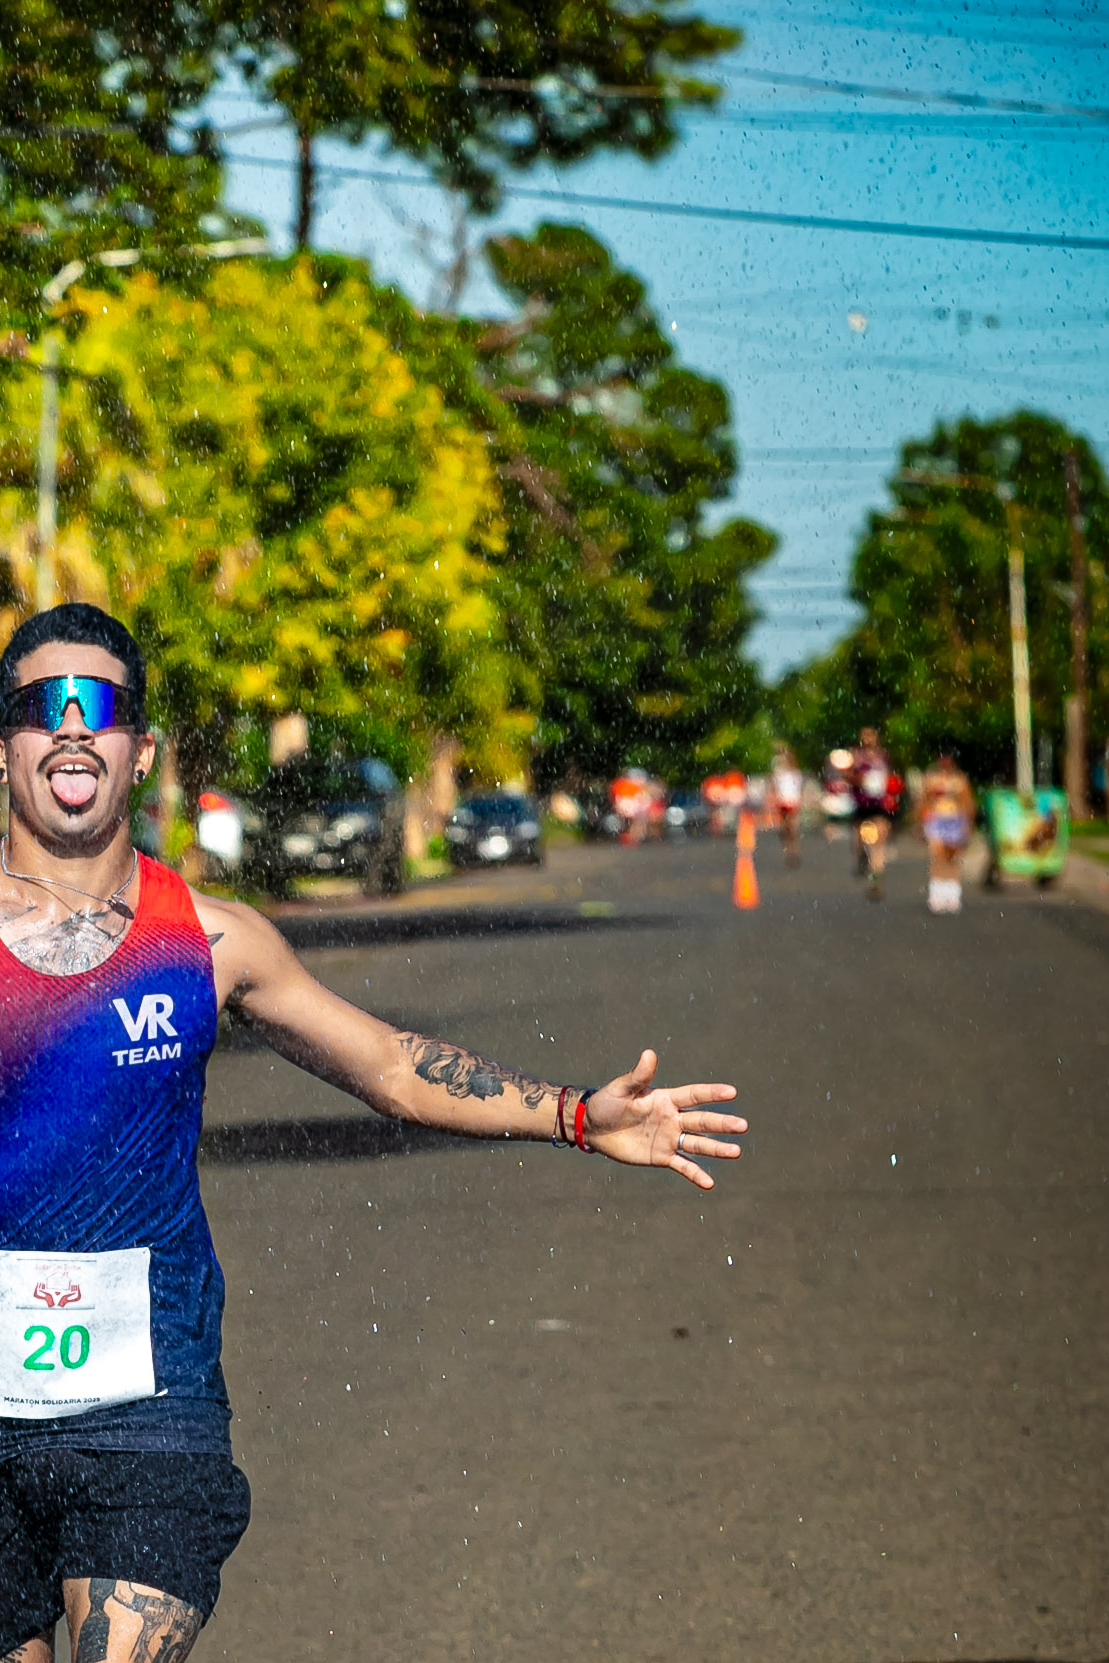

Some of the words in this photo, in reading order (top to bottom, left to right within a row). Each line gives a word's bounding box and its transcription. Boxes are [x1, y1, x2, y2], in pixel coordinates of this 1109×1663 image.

[112, 993, 178, 1042] VR
[112, 1043, 181, 1067] TEAM
[23, 1325, 90, 1371] 20
